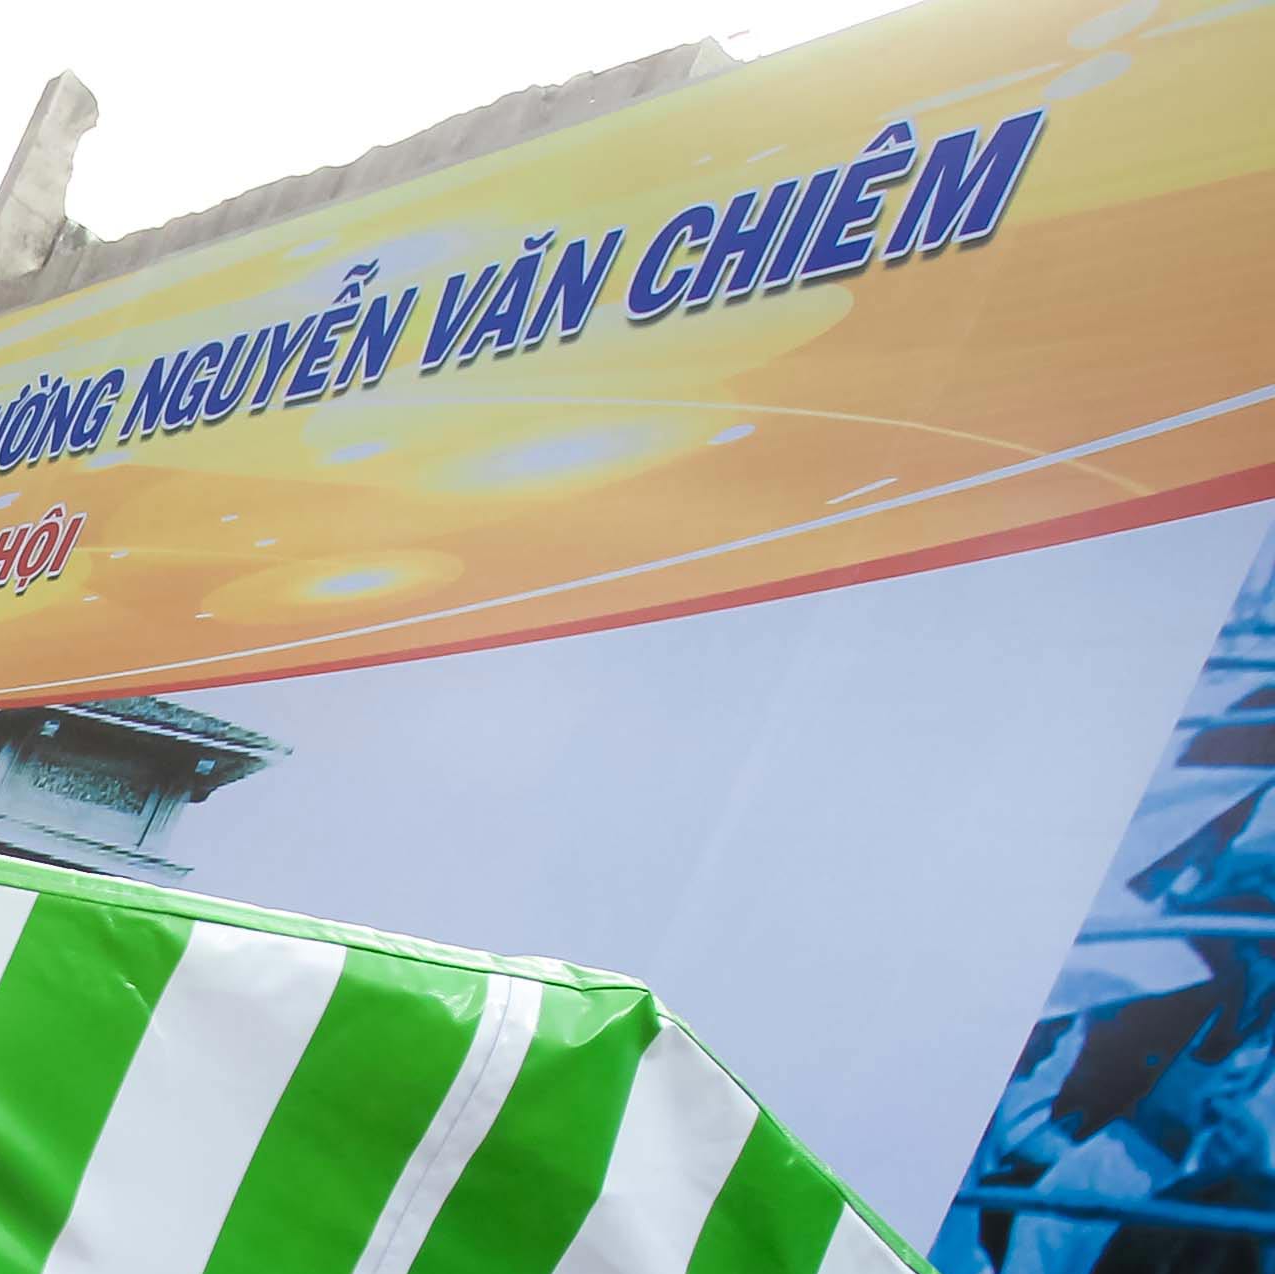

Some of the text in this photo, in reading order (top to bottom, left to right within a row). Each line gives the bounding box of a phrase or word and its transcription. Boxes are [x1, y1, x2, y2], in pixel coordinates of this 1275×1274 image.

[118, 257, 419, 442] NGUYỄN
[419, 226, 627, 371] VĂN
[626, 106, 1046, 320] CHIÊM
